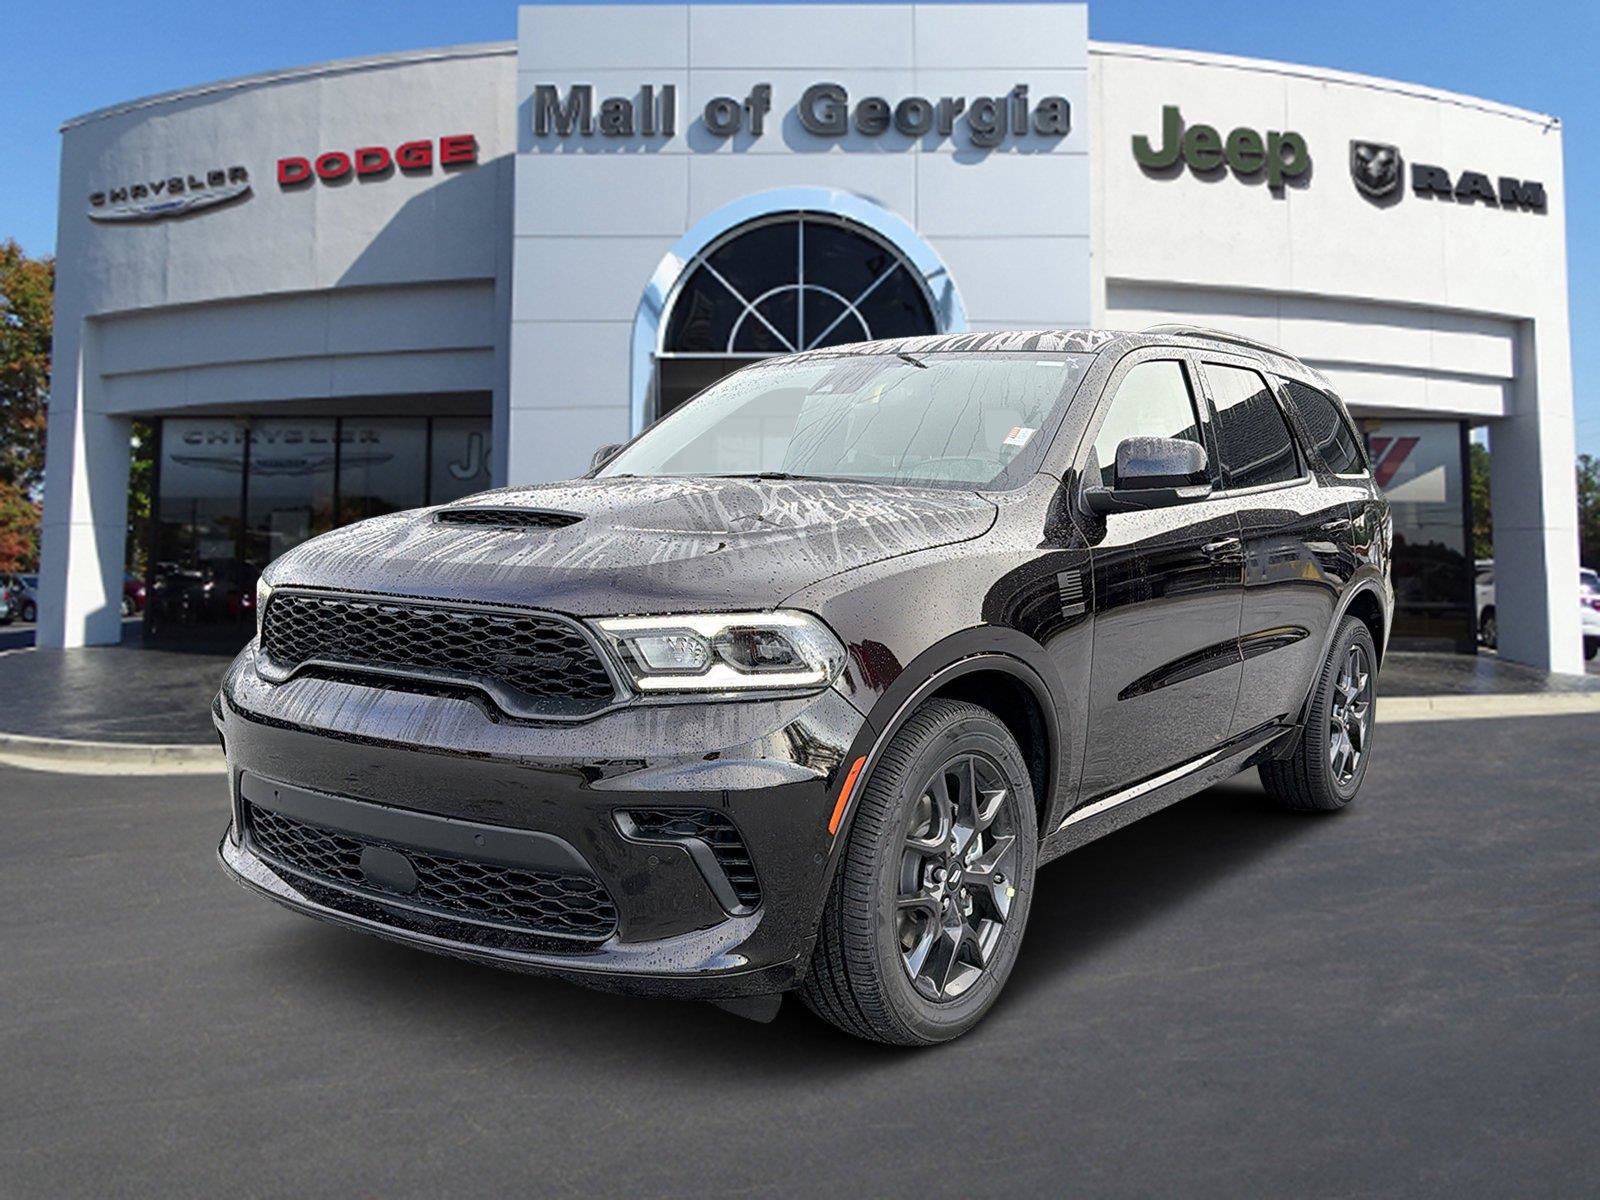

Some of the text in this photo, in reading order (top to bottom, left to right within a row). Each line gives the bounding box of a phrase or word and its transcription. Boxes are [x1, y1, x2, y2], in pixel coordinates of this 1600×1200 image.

[532, 82, 1071, 147] Mall of Georgia
[277, 134, 478, 190] DODGE
[1132, 105, 1310, 195] Jeep
[89, 165, 249, 207] CHRYSLER
[1411, 162, 1548, 214] RAM
[182, 429, 381, 445] CHRYSLER
